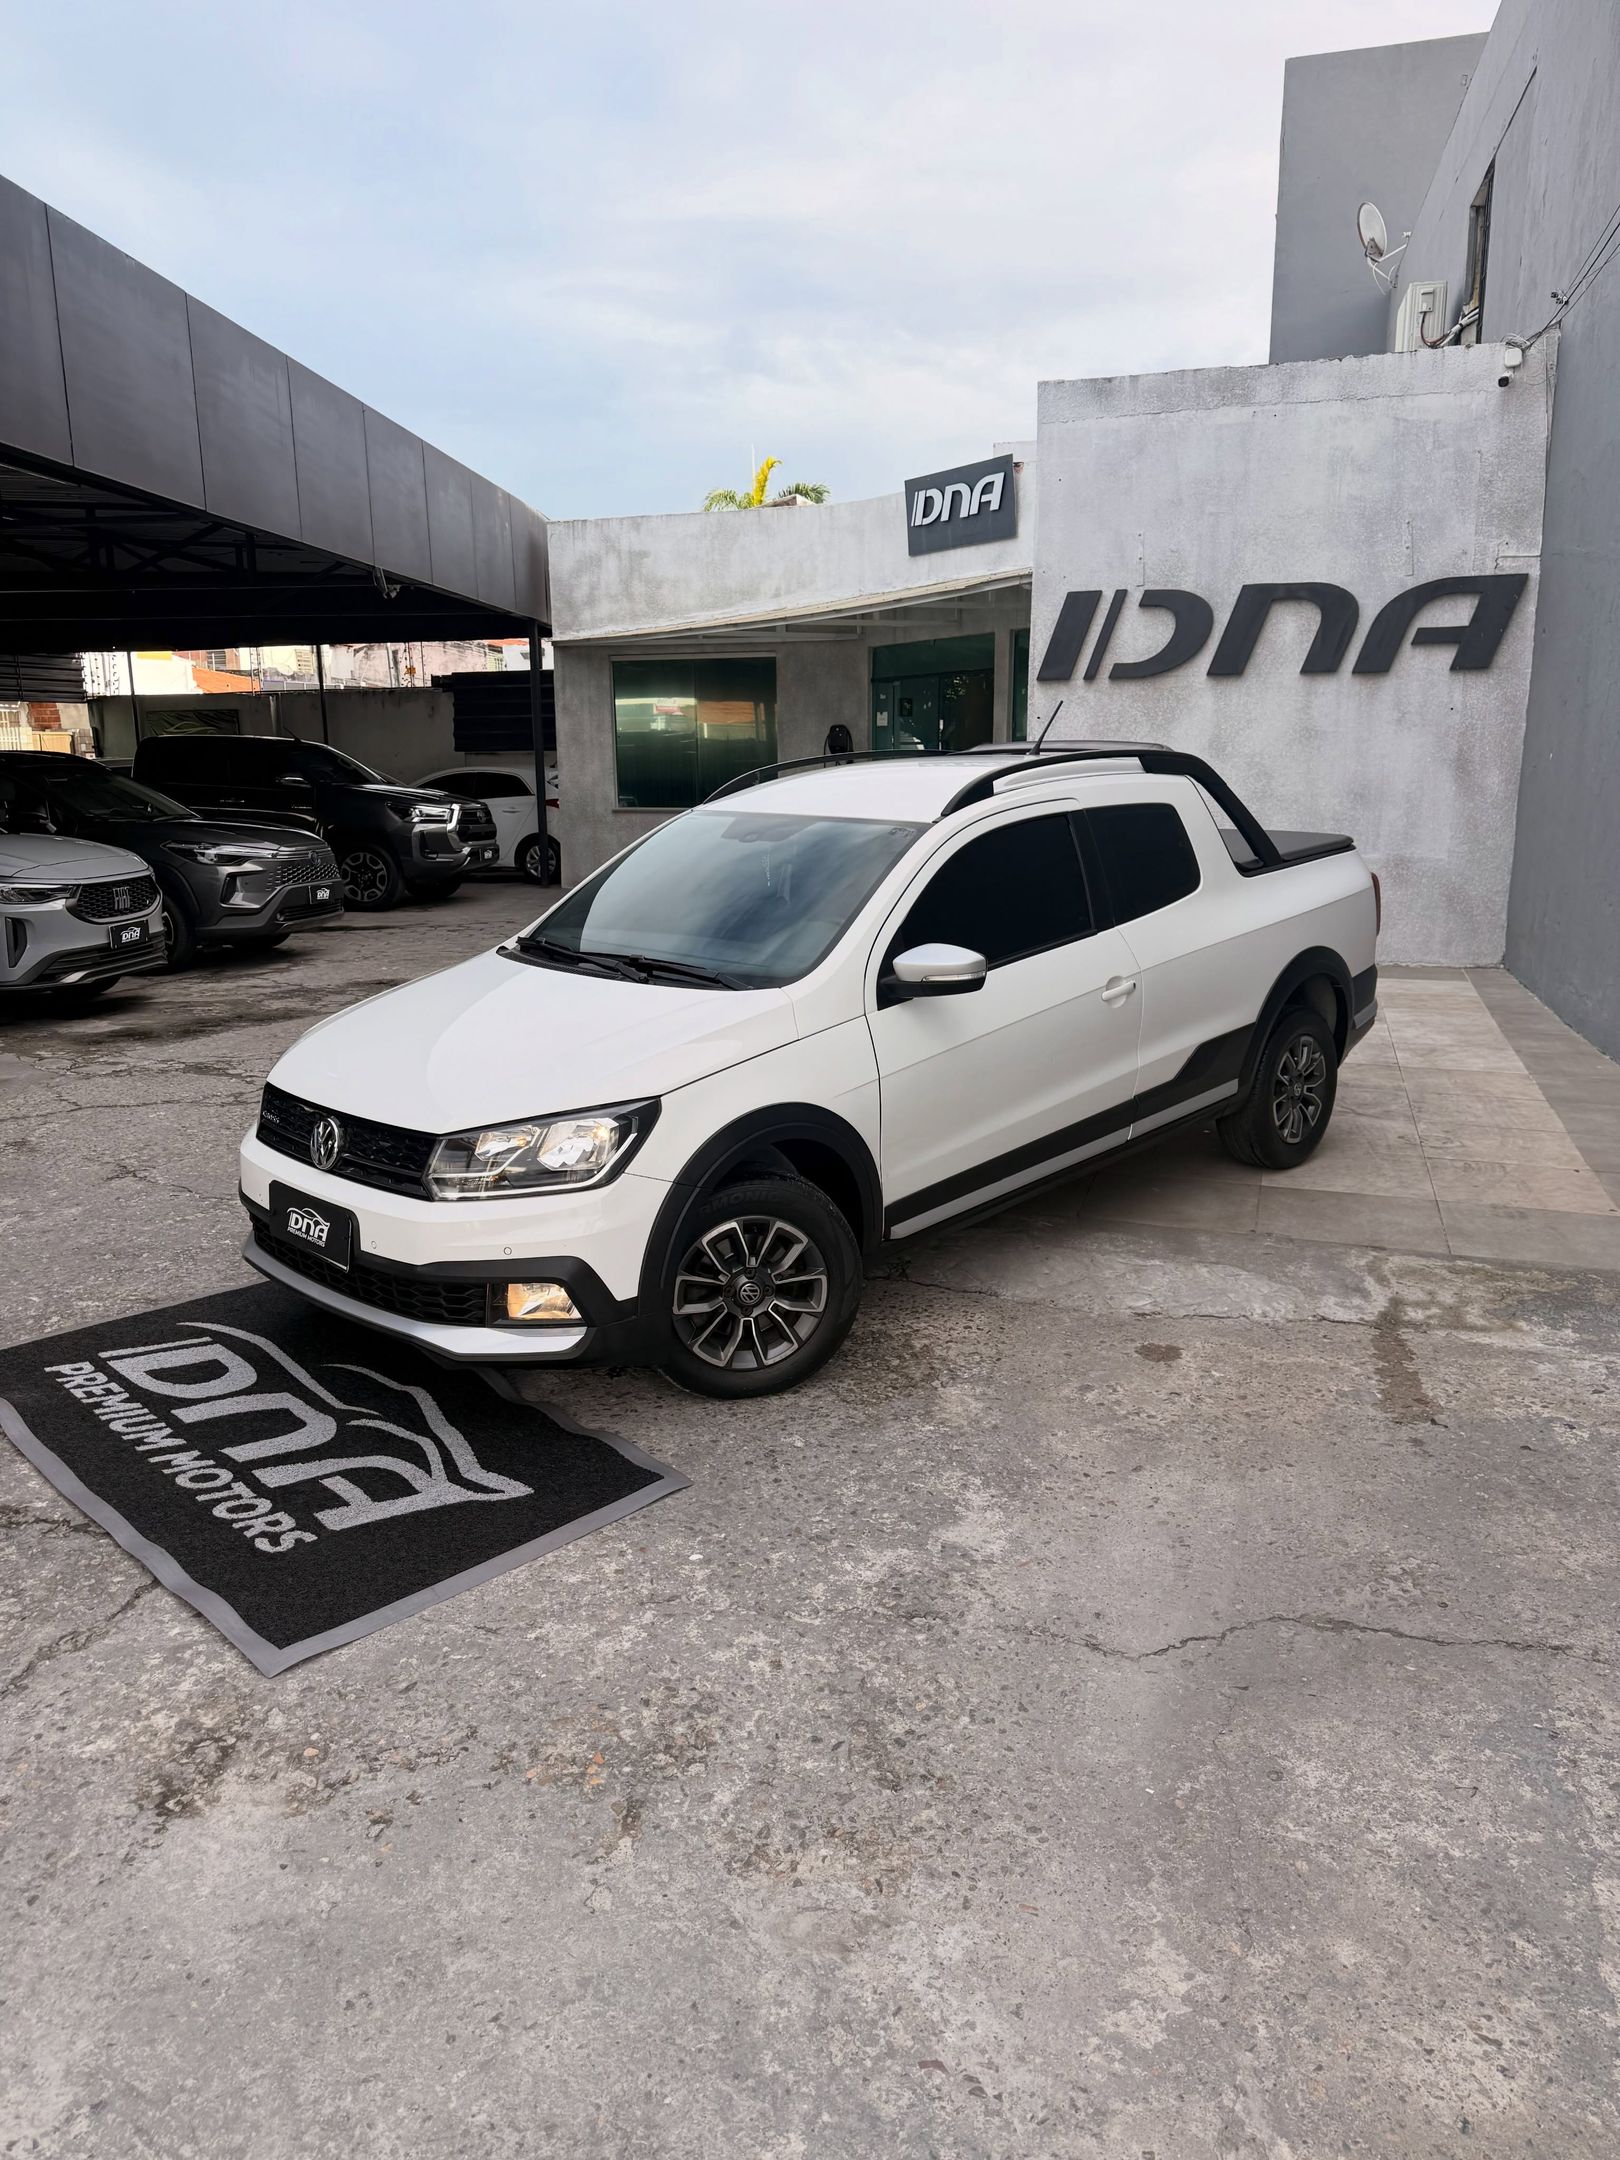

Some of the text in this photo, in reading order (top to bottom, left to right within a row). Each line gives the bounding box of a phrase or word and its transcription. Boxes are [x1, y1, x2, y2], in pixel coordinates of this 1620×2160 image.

[910, 472, 1005, 527] DNA
[1037, 573, 1529, 681] DNA
[288, 1211, 329, 1242] DNA
[43, 1361, 318, 1553] PREMIUM MOTORS
[97, 1336, 465, 1531] DNA
